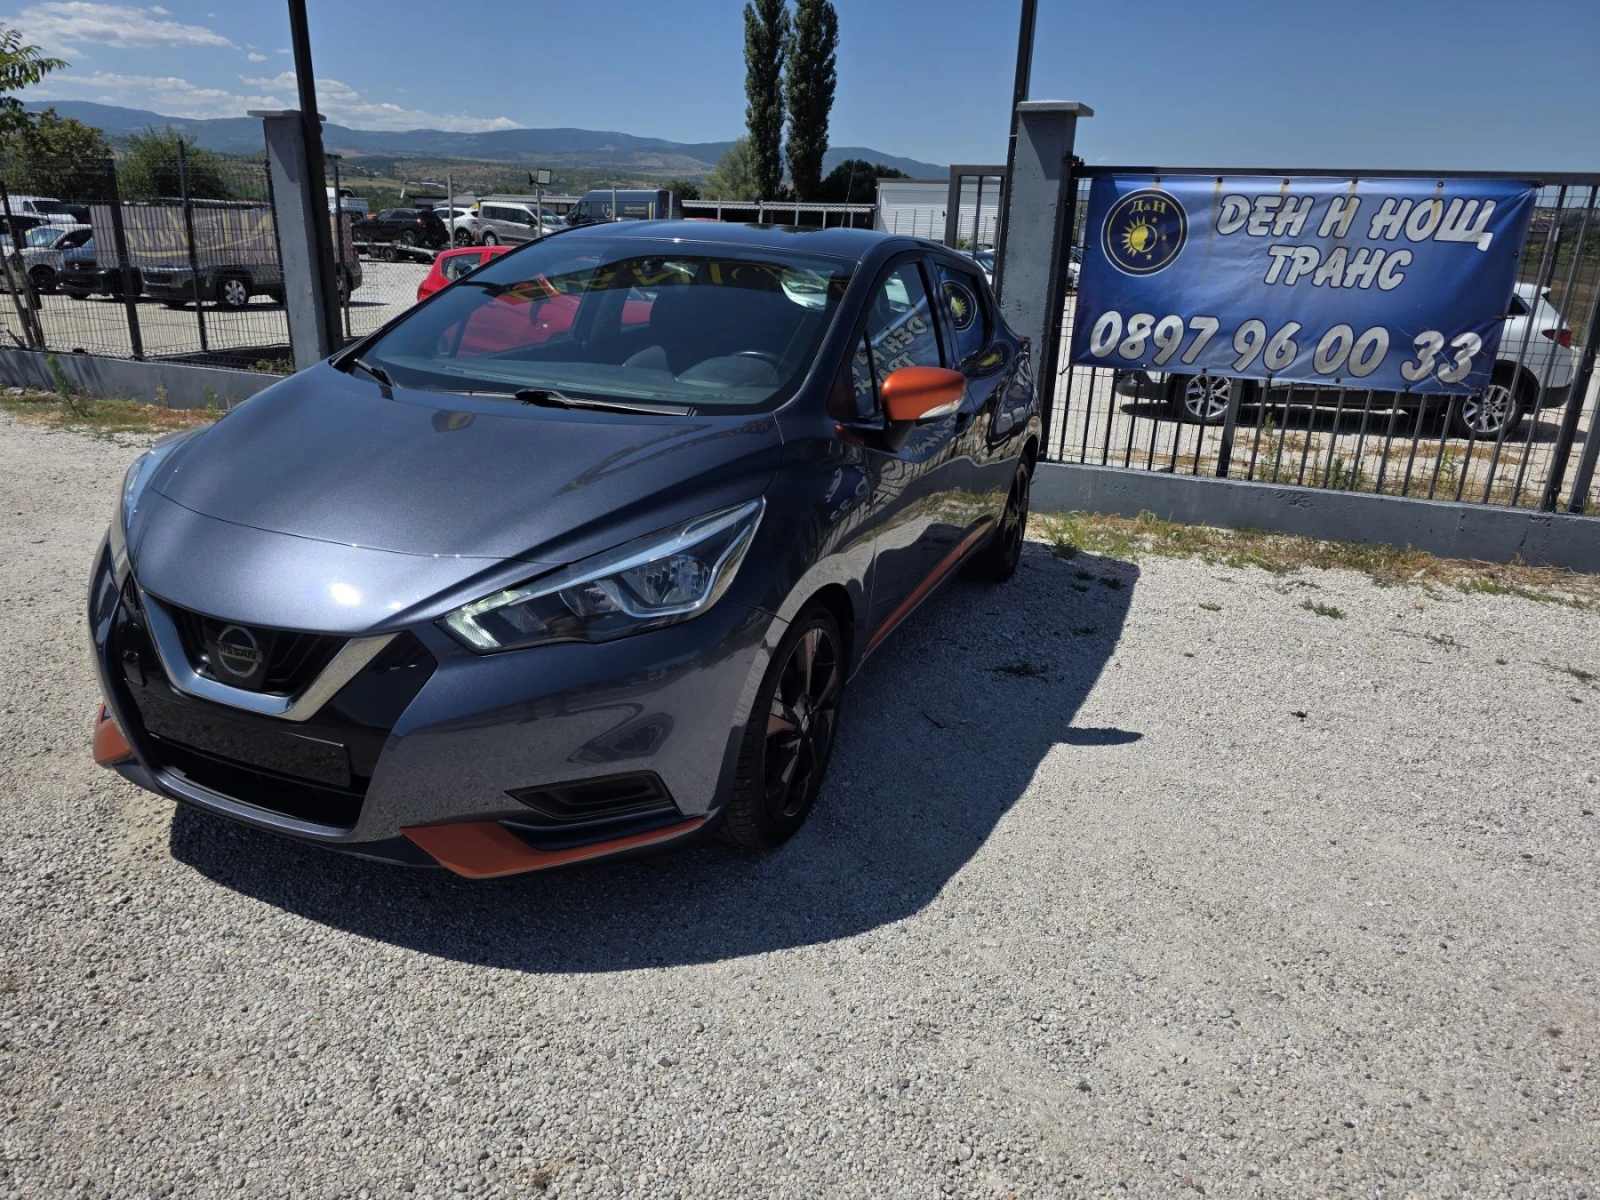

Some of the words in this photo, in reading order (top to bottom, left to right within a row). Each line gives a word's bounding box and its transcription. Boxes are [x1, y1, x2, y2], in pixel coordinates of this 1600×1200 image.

[1367, 197, 1497, 252] НОЩ
[1264, 244, 1414, 291] ТРАНС
[1089, 310, 1220, 366] 0897
[1231, 318, 1302, 373] 96
[1312, 323, 1390, 378] 00
[1400, 330, 1482, 383] 33
[219, 645, 257, 660] NISSAN
